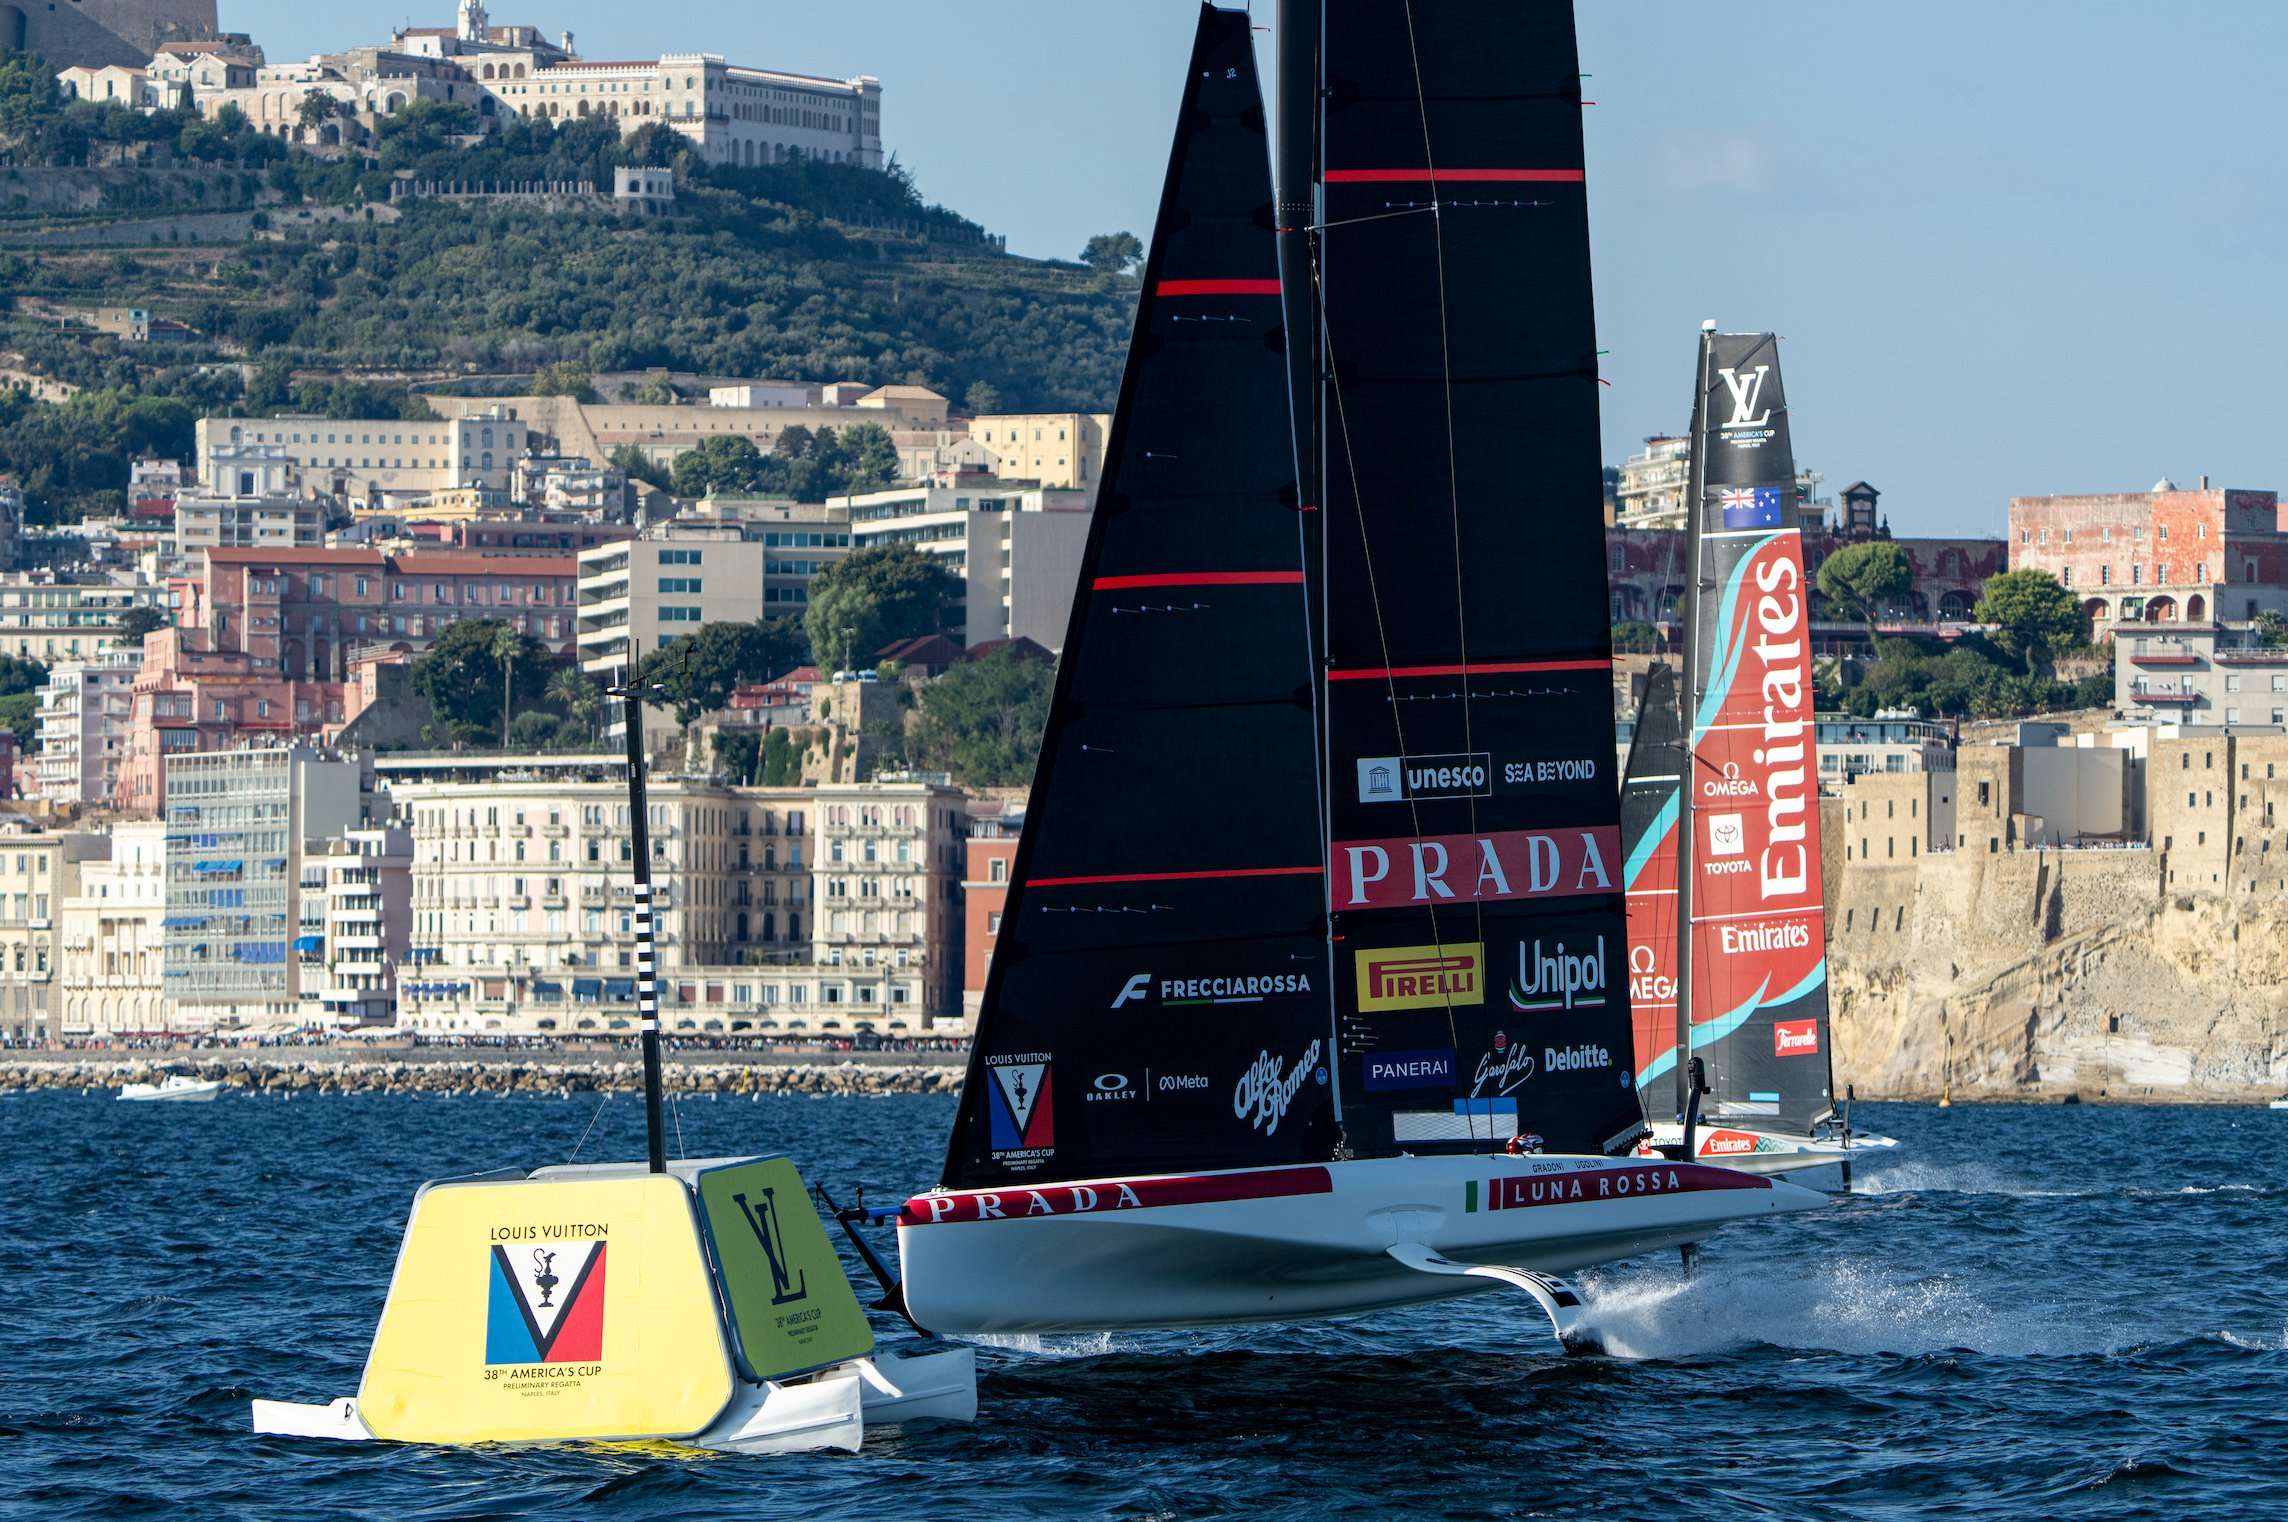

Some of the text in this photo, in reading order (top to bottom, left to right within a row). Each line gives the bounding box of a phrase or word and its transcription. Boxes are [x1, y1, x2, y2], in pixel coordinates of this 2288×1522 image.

[1752, 556, 1807, 901] Emirates
[1408, 765, 1485, 789] unesco
[1703, 780, 1759, 797] OMEGA
[1344, 832, 1613, 904] PRADA
[1704, 860, 1753, 875] TOYOTA
[1720, 922, 1809, 954] Emirates
[1368, 955, 1475, 999] PIRELLI
[1519, 935, 1605, 1010] Unipol
[1161, 974, 1311, 999] FRECCIAROSSA
[985, 1051, 1052, 1066] LOUIS VUITTON
[1372, 1060, 1448, 1079] PANERAI
[1176, 1074, 1209, 1090] Meta
[1086, 1090, 1136, 1101] OAKLEY
[1653, 1138, 1683, 1146] TOYOT
[1709, 1136, 1751, 1153] Emirates
[1006, 1150, 1040, 1159] AMERICA'S
[1041, 1149, 1055, 1157] CUP
[1532, 1162, 1564, 1174] GRADONI
[1515, 1170, 1680, 1202] LUNA ROSSA
[930, 1183, 1143, 1223] PRADA
[490, 1222, 609, 1242] LOUIS VUITTON
[510, 1366, 575, 1379] AMERICA'S
[577, 1365, 602, 1377] CUP
[503, 1380, 581, 1390] PRELIMINARY REGATTA
